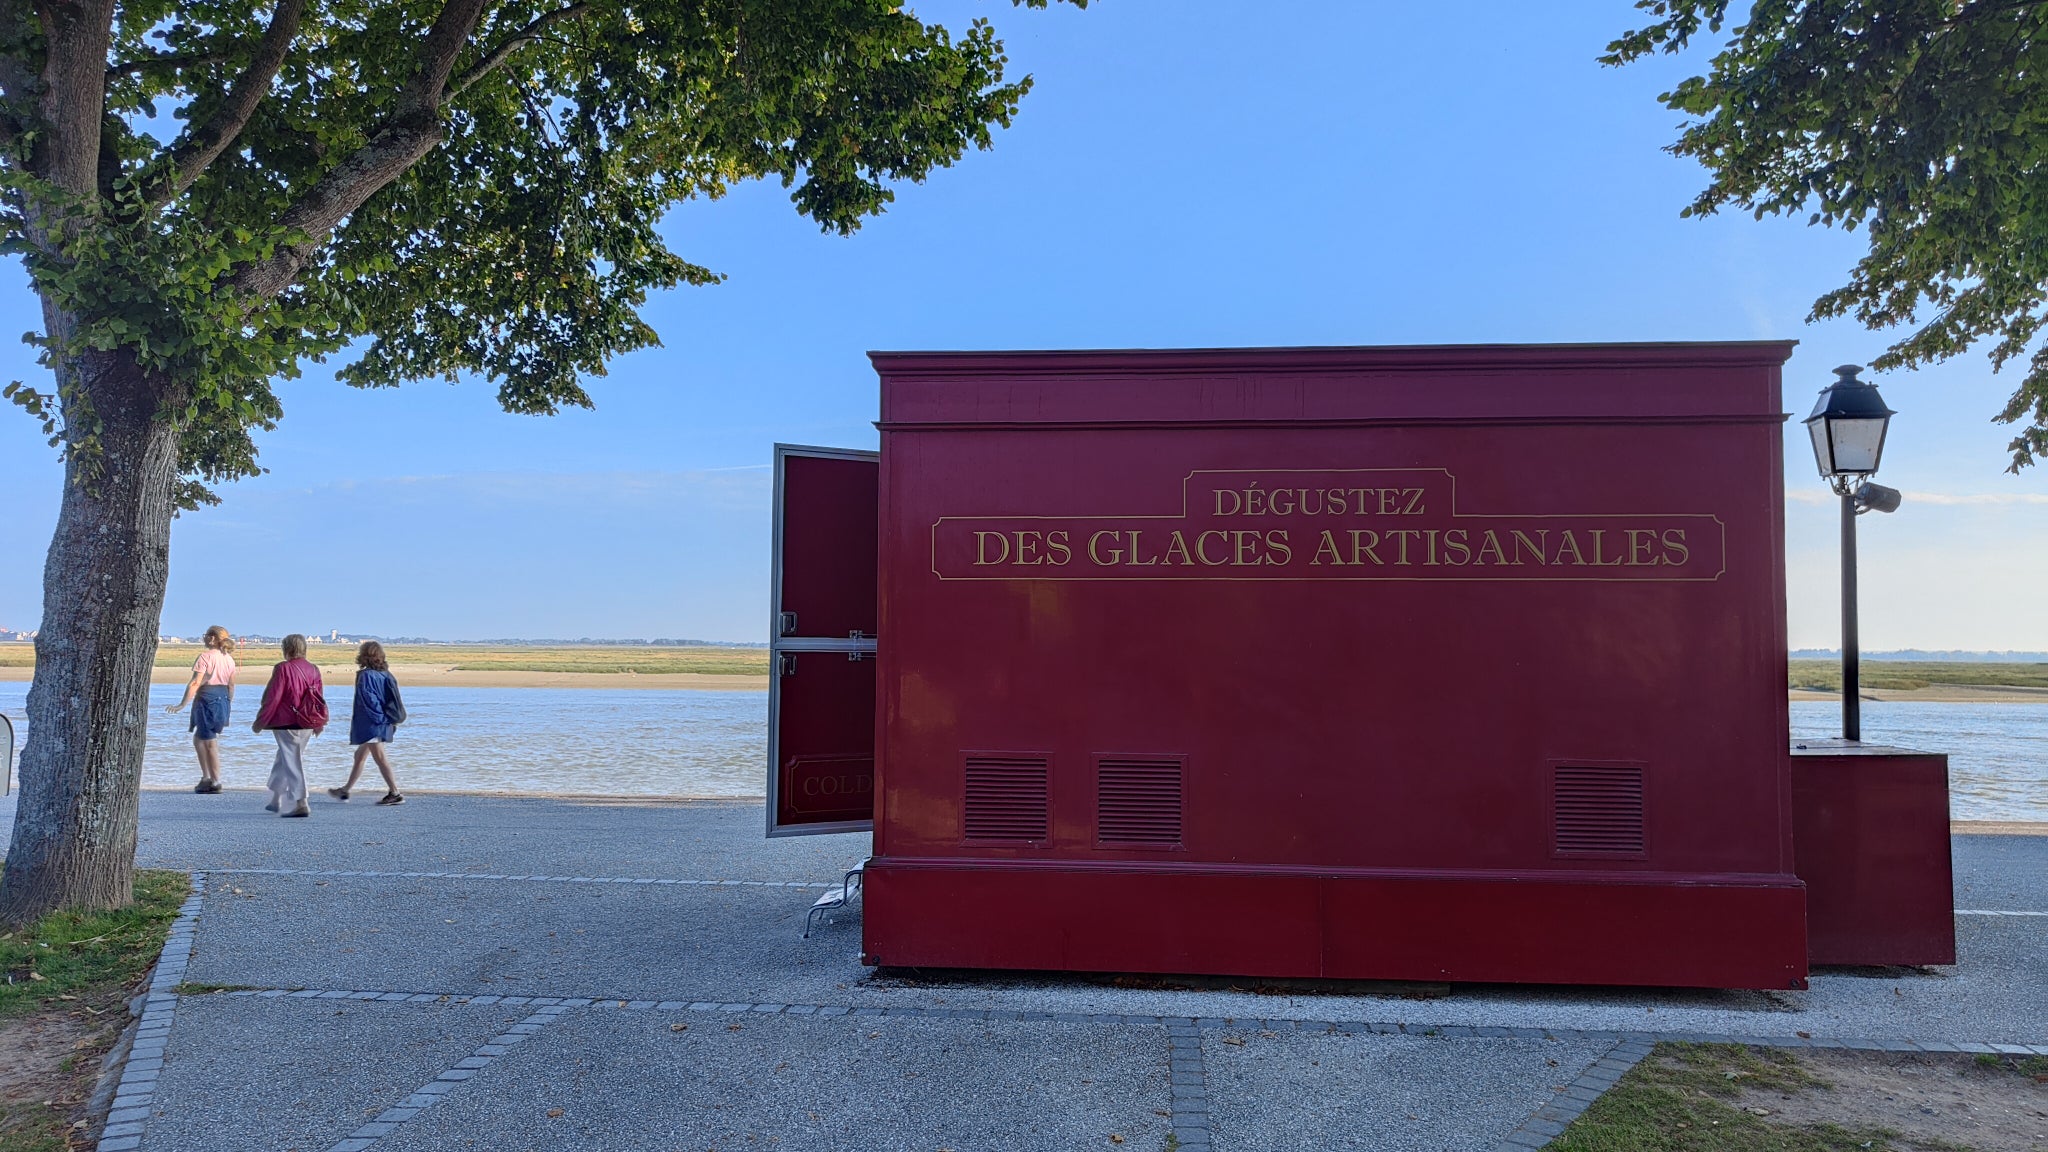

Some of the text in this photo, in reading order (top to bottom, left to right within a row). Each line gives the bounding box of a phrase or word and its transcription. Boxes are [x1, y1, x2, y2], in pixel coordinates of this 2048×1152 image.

[1213, 481, 1426, 517] DÉGUSTEZ
[973, 529, 1690, 567] DES GLACES ARTISANALES
